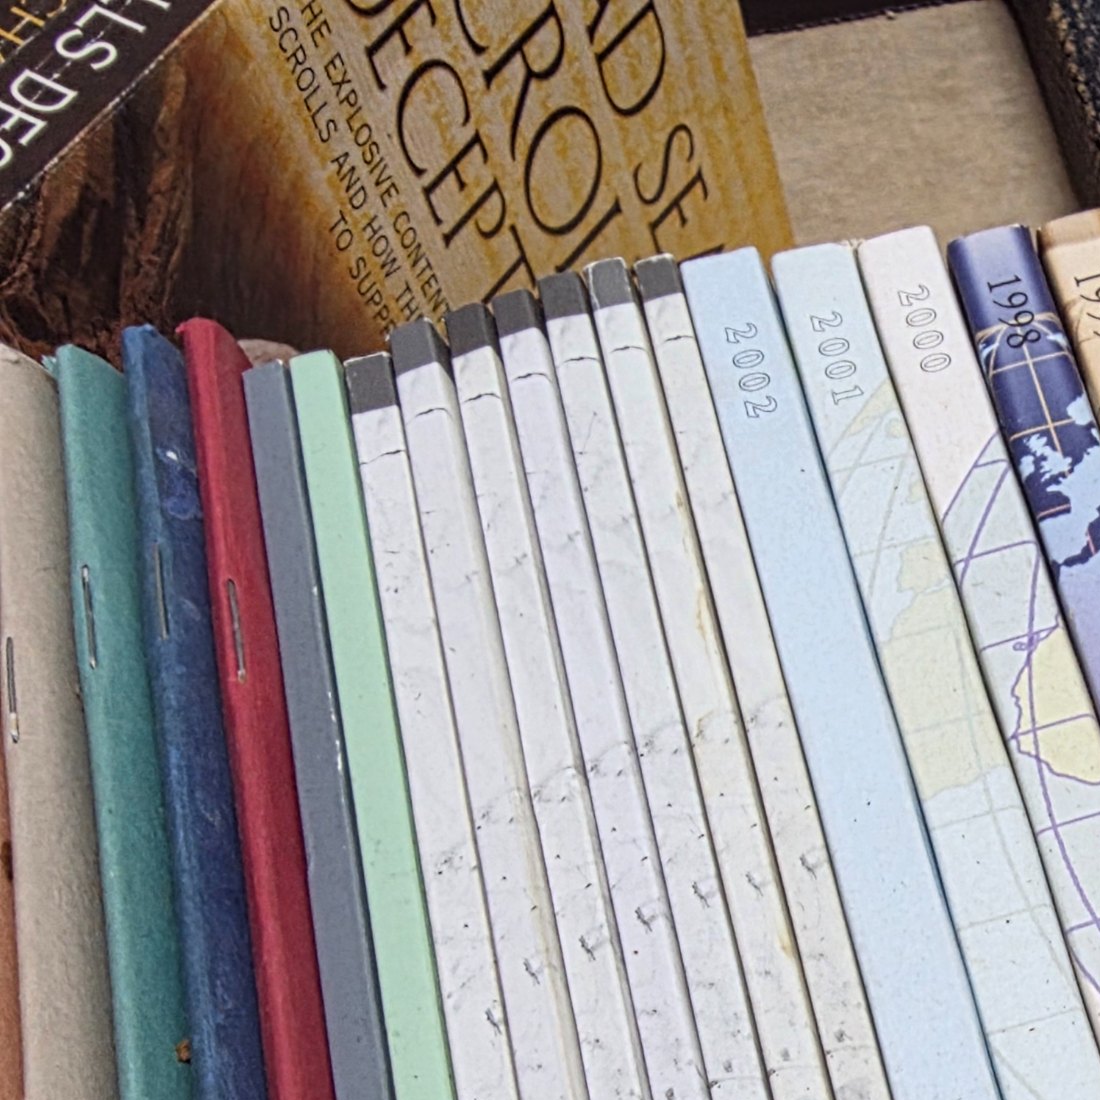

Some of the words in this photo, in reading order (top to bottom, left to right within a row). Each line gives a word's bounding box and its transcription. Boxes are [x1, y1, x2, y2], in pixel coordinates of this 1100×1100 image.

[55, 0, 171, 71] LS
[269, 6, 338, 143] SCROLLS
[331, 152, 367, 210] AND
[363, 215, 401, 278] HOW
[396, 280, 424, 322] TH
[324, 53, 399, 208] EXPLOSIVE
[345, 0, 537, 303] ECEPT
[585, 0, 666, 117] D
[633, 123, 725, 267] SE
[329, 210, 354, 252] TO
[810, 310, 865, 406] 2001
[897, 283, 952, 374] 2000
[987, 273, 1041, 350] 1998
[725, 321, 778, 420] 2002
